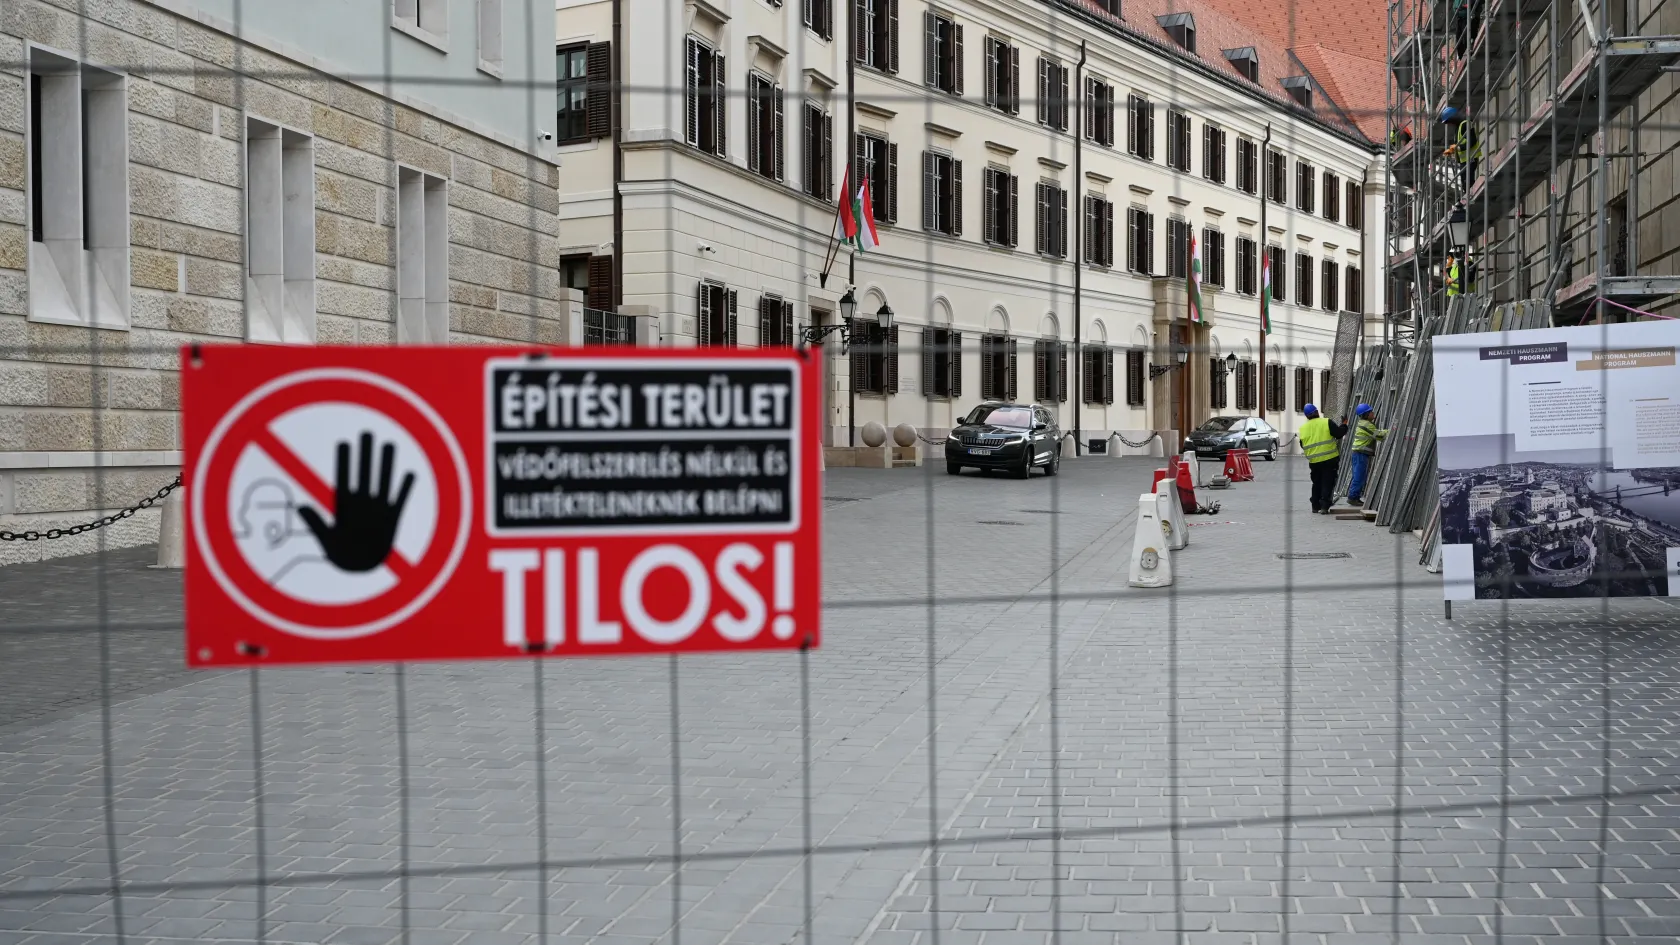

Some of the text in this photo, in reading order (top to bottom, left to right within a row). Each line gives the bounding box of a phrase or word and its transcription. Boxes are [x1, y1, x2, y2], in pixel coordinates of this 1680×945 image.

[1488, 346, 1558, 357] NEMZETI HAUSZMANN
[1519, 353, 1551, 361] PROGRAM
[1594, 350, 1671, 361] NATIONAL HAUSZMANN
[1603, 359, 1637, 367] PROGRAM
[501, 371, 789, 428] ÉPÍTÉSI TERÜLET
[498, 445, 788, 480] VÉDŐFELSZERELÉS NÉLKÜL ÉS
[503, 483, 782, 519] ILLETÉKTELENEKNEK BELÉPNI
[487, 541, 796, 646] TILOS!
